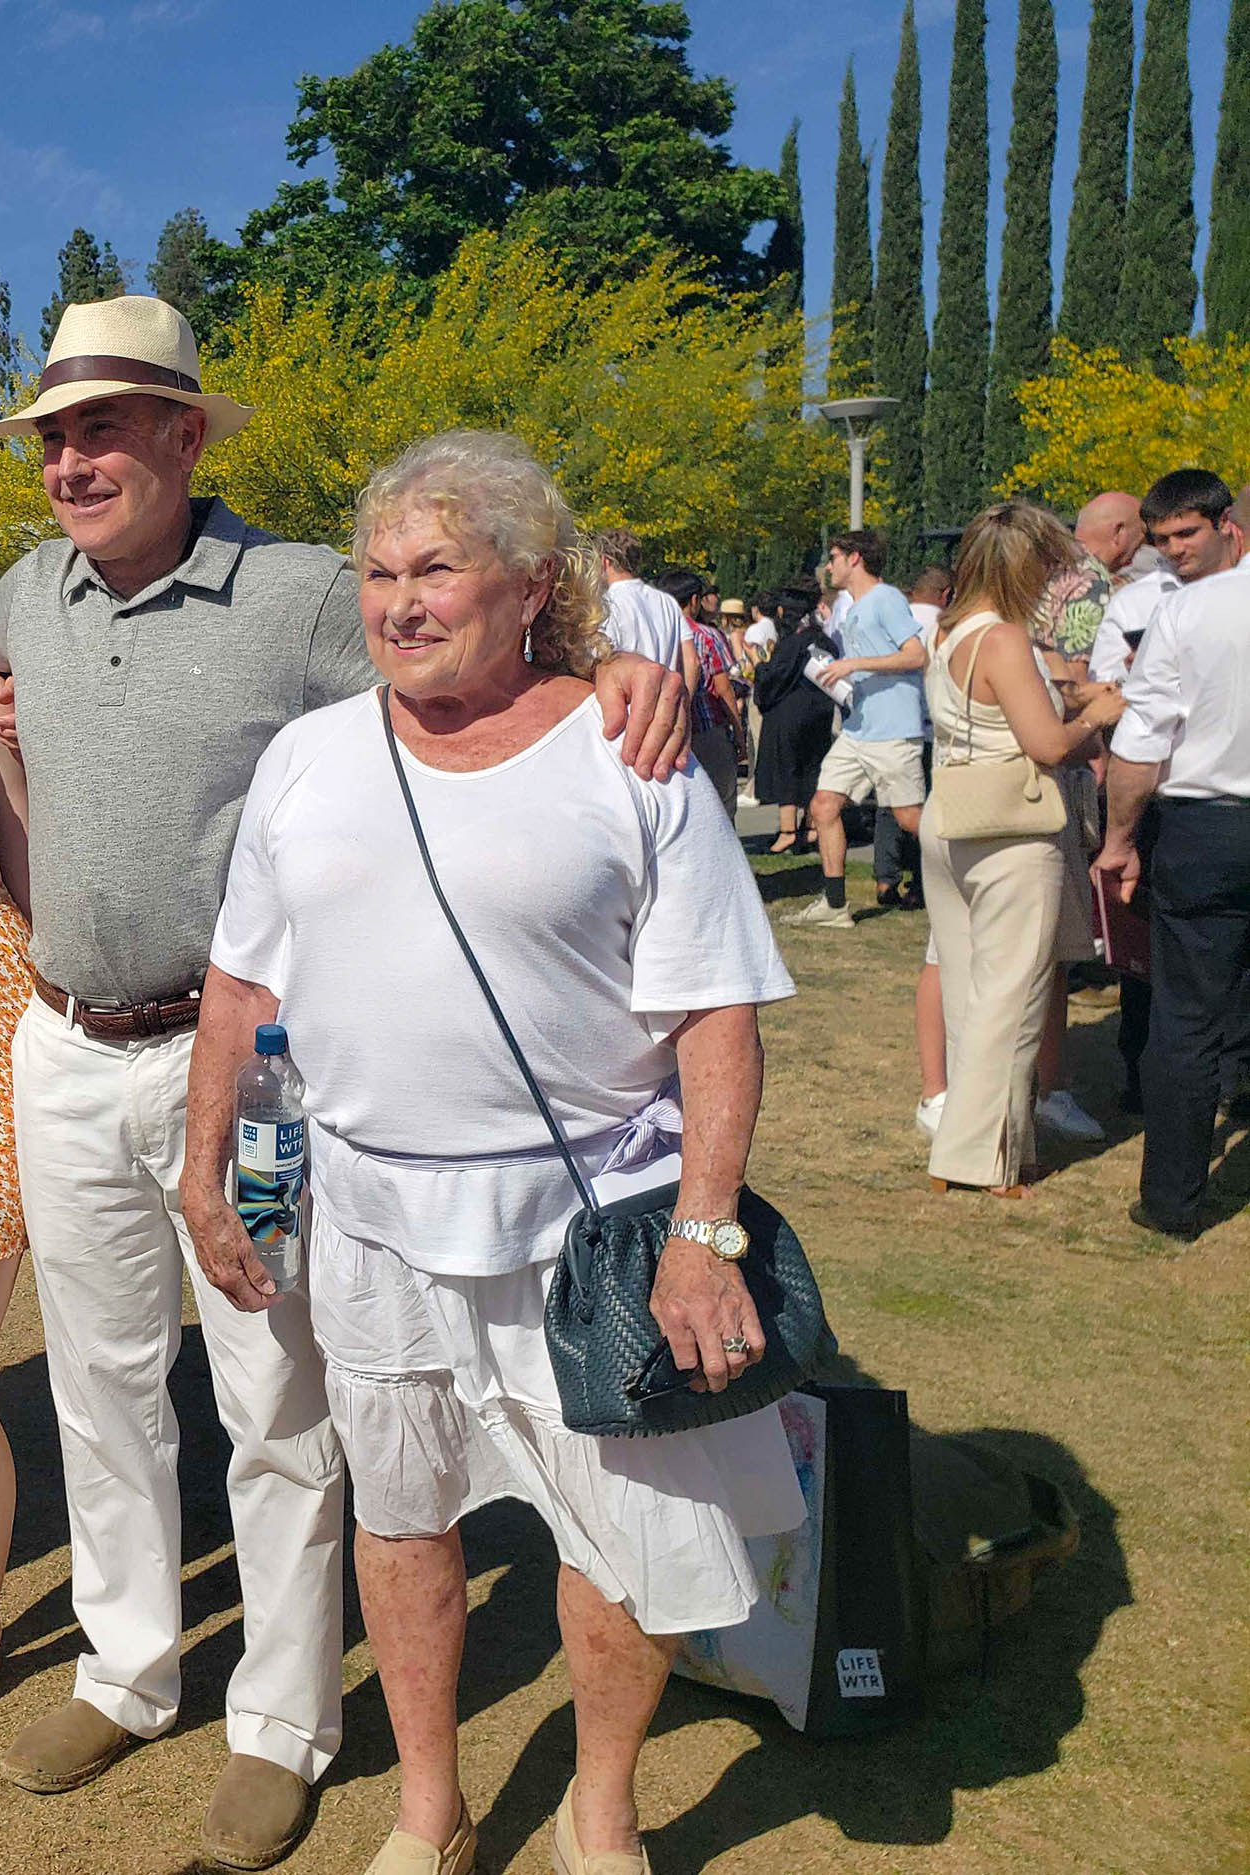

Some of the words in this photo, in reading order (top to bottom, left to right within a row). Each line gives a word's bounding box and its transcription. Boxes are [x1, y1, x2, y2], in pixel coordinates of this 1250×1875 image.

[280, 1124, 303, 1141] LIFE
[840, 1656, 876, 1670] LIFE
[843, 1675, 880, 1688] WTR
